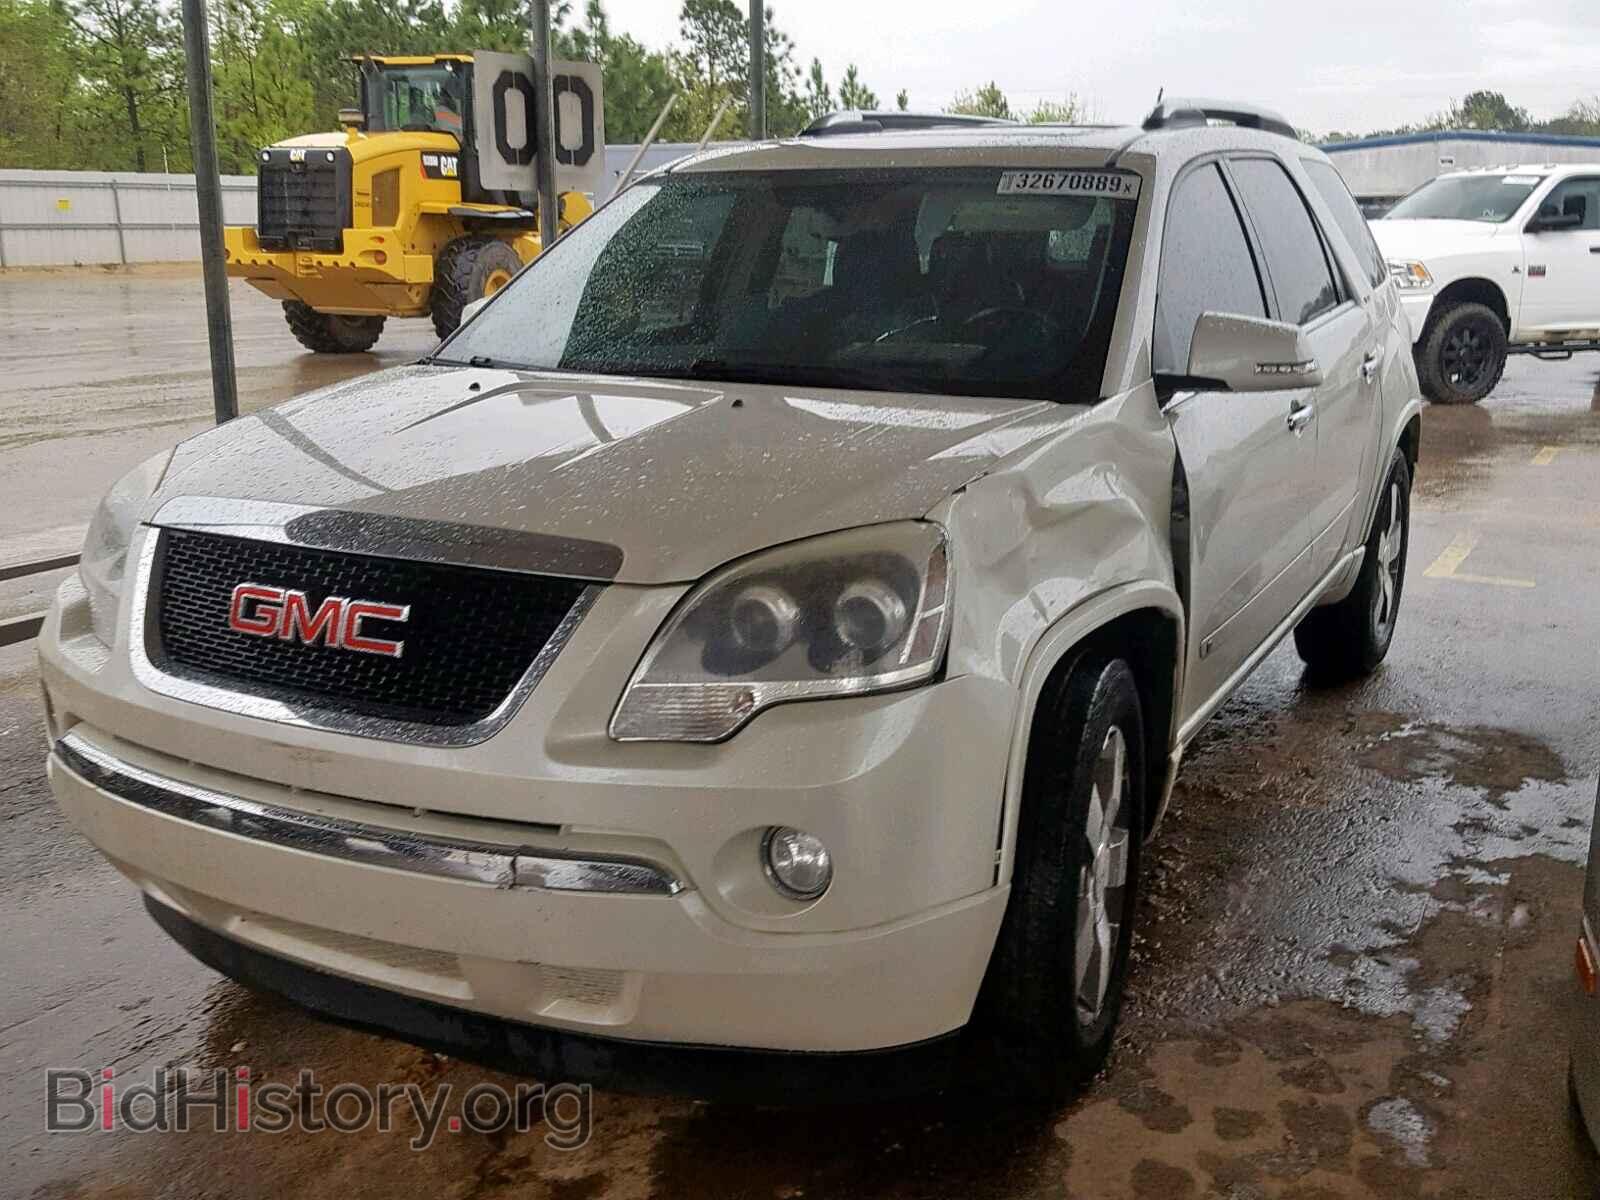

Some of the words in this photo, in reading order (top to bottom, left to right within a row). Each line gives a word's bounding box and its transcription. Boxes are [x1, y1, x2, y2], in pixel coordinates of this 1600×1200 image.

[290, 149, 307, 161] CAT
[440, 155, 458, 177] CAT
[1015, 173, 1122, 192] 32670889
[229, 582, 411, 658] GMC
